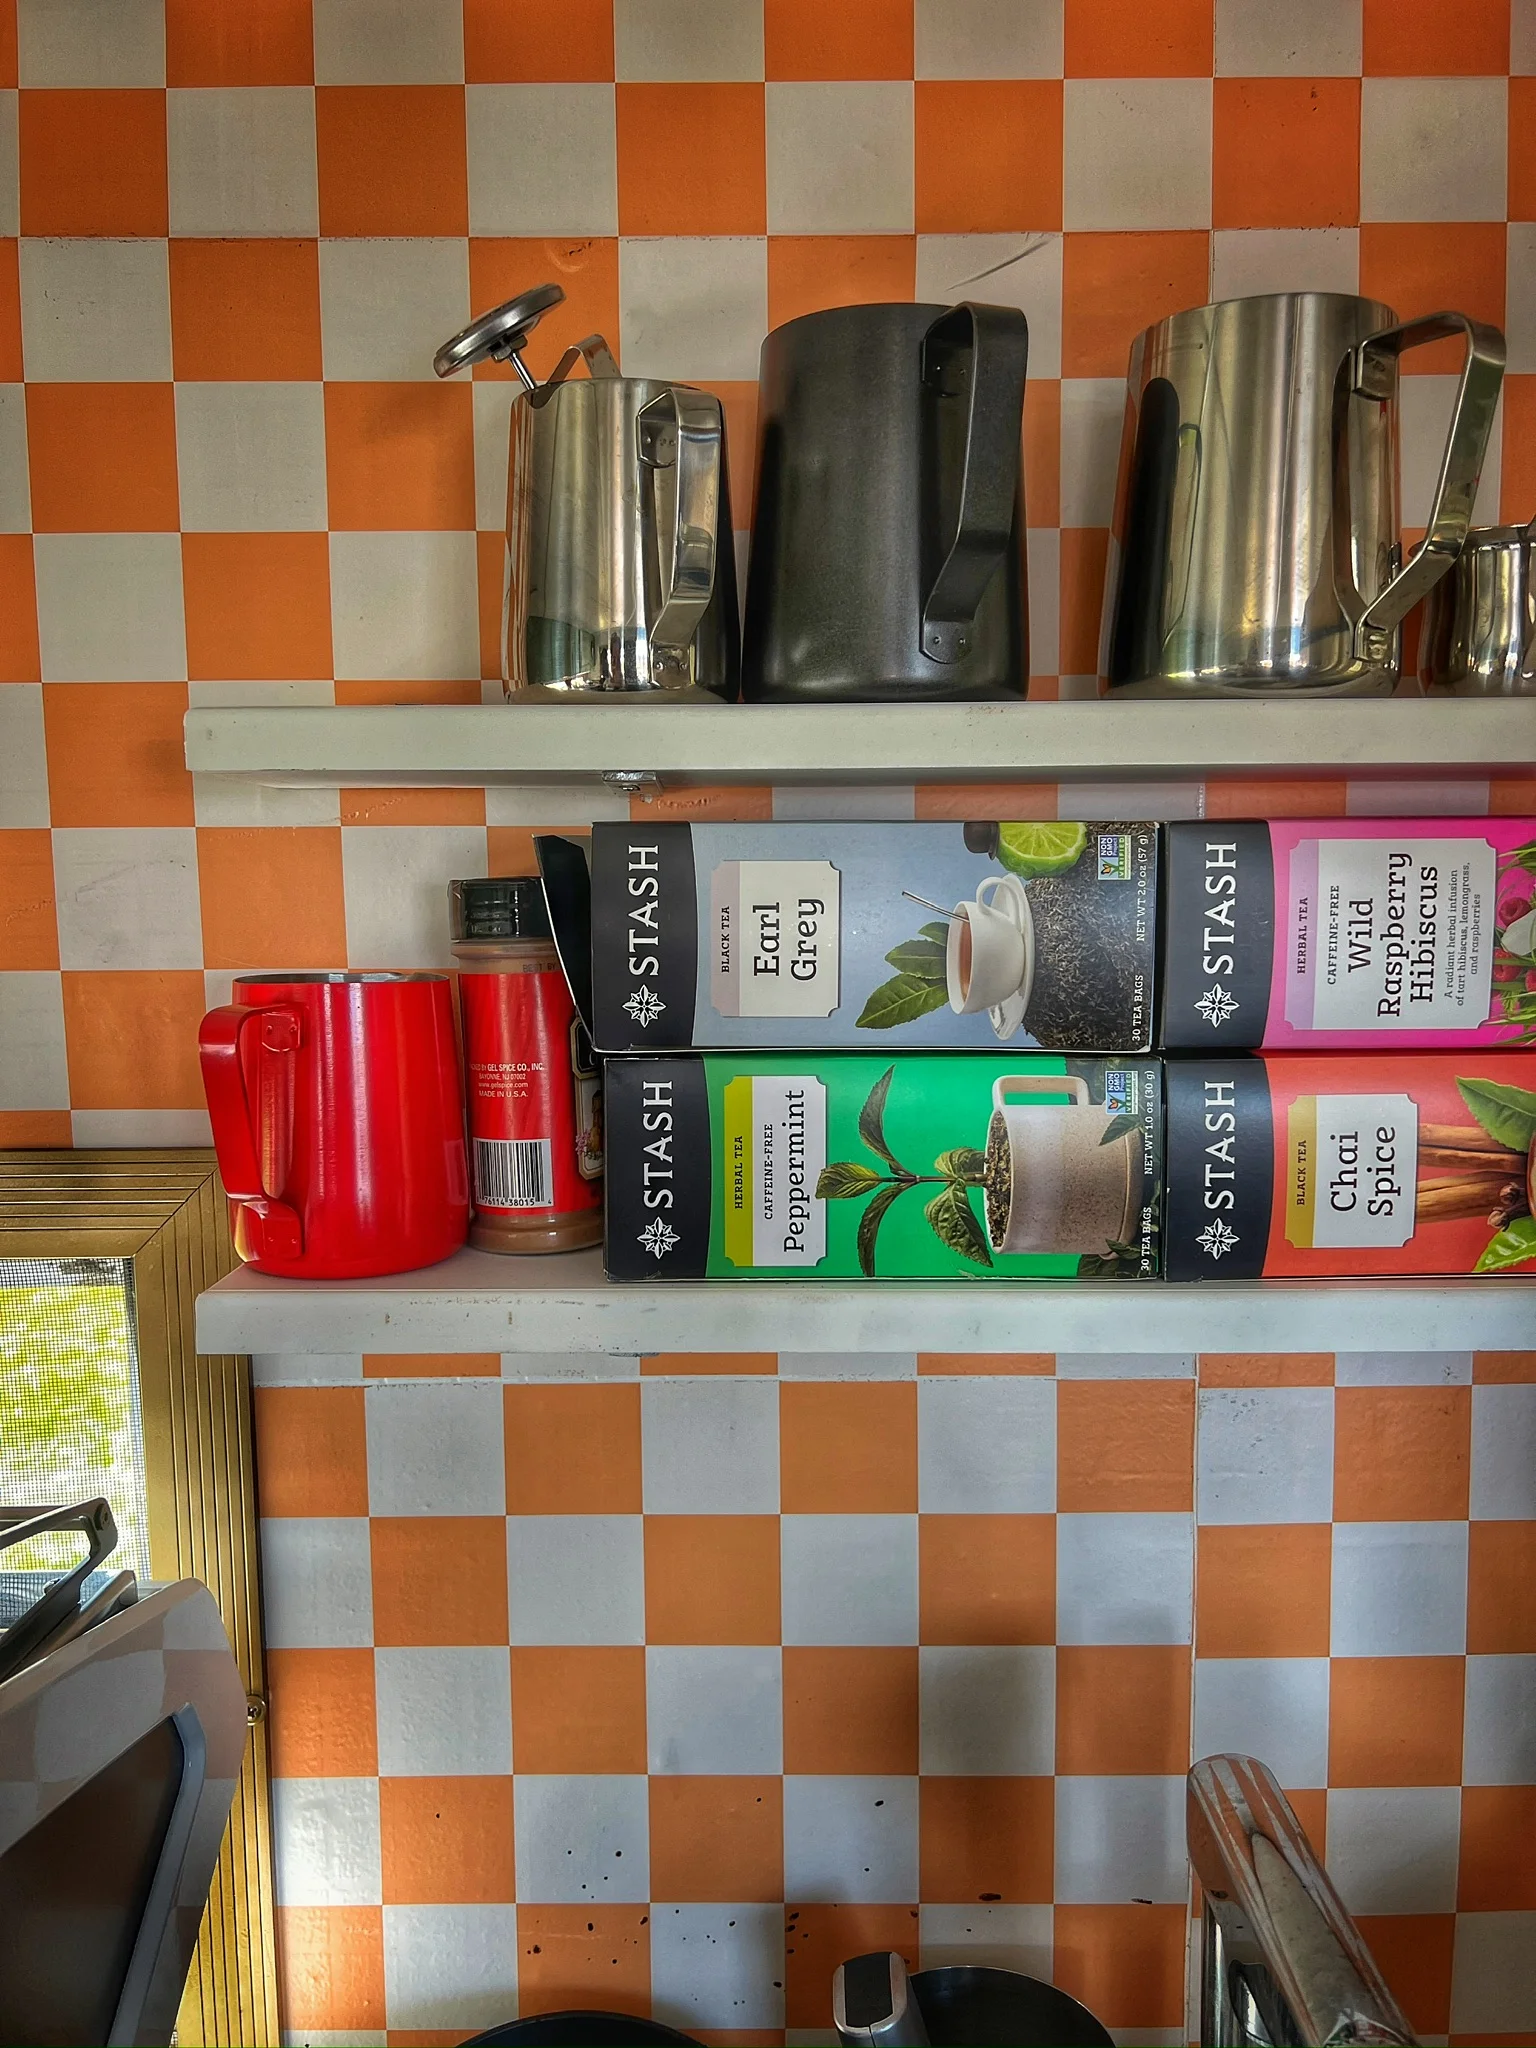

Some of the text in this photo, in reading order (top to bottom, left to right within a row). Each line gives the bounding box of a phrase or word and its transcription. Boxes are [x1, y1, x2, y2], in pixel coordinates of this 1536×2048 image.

[628, 845, 659, 976] STASH
[1137, 834, 1149, 942] NET WT 2.0 oz (57 g)
[1202, 842, 1237, 975] STASH
[721, 905, 730, 973] BLACK TEA
[752, 902, 780, 977] Earl
[790, 898, 825, 981] Grey
[1297, 897, 1309, 974] HERBAL TEA
[1327, 885, 1340, 985] CAFFEINE-FREE
[1347, 898, 1373, 973] Wild
[1377, 853, 1413, 1017] Raspberry
[1409, 866, 1438, 1003] Hibiscus
[1444, 870, 1458, 999] A radiant herbal infusion
[1456, 862, 1471, 1006] of tart hibiscus, lemongrass,
[1469, 893, 1481, 975] and raspberries
[1132, 975, 1144, 1042] 30 TEA BAGS
[487, 1063, 498, 1072] GEL
[499, 1063, 516, 1072] SPICE
[531, 1062, 545, 1071] INC.
[496, 1090, 505, 1098] IN
[506, 1090, 528, 1098] U.S.A.
[643, 1080, 674, 1208] STASH
[1144, 1070, 1155, 1175] NET WT 1.0 oz (30 g)
[1203, 1080, 1236, 1210] STASH
[508, 1198, 535, 1207] 38015
[735, 1136, 743, 1209] HERBAL TEA
[764, 1124, 773, 1219] CAFFEINE-FREE
[782, 1090, 810, 1252] Peppermint
[1296, 1140, 1307, 1206] BLACK TEA
[1329, 1131, 1358, 1212] Chai
[1366, 1126, 1401, 1217] Spice
[1141, 1207, 1152, 1271] 30 TEA BAGS
